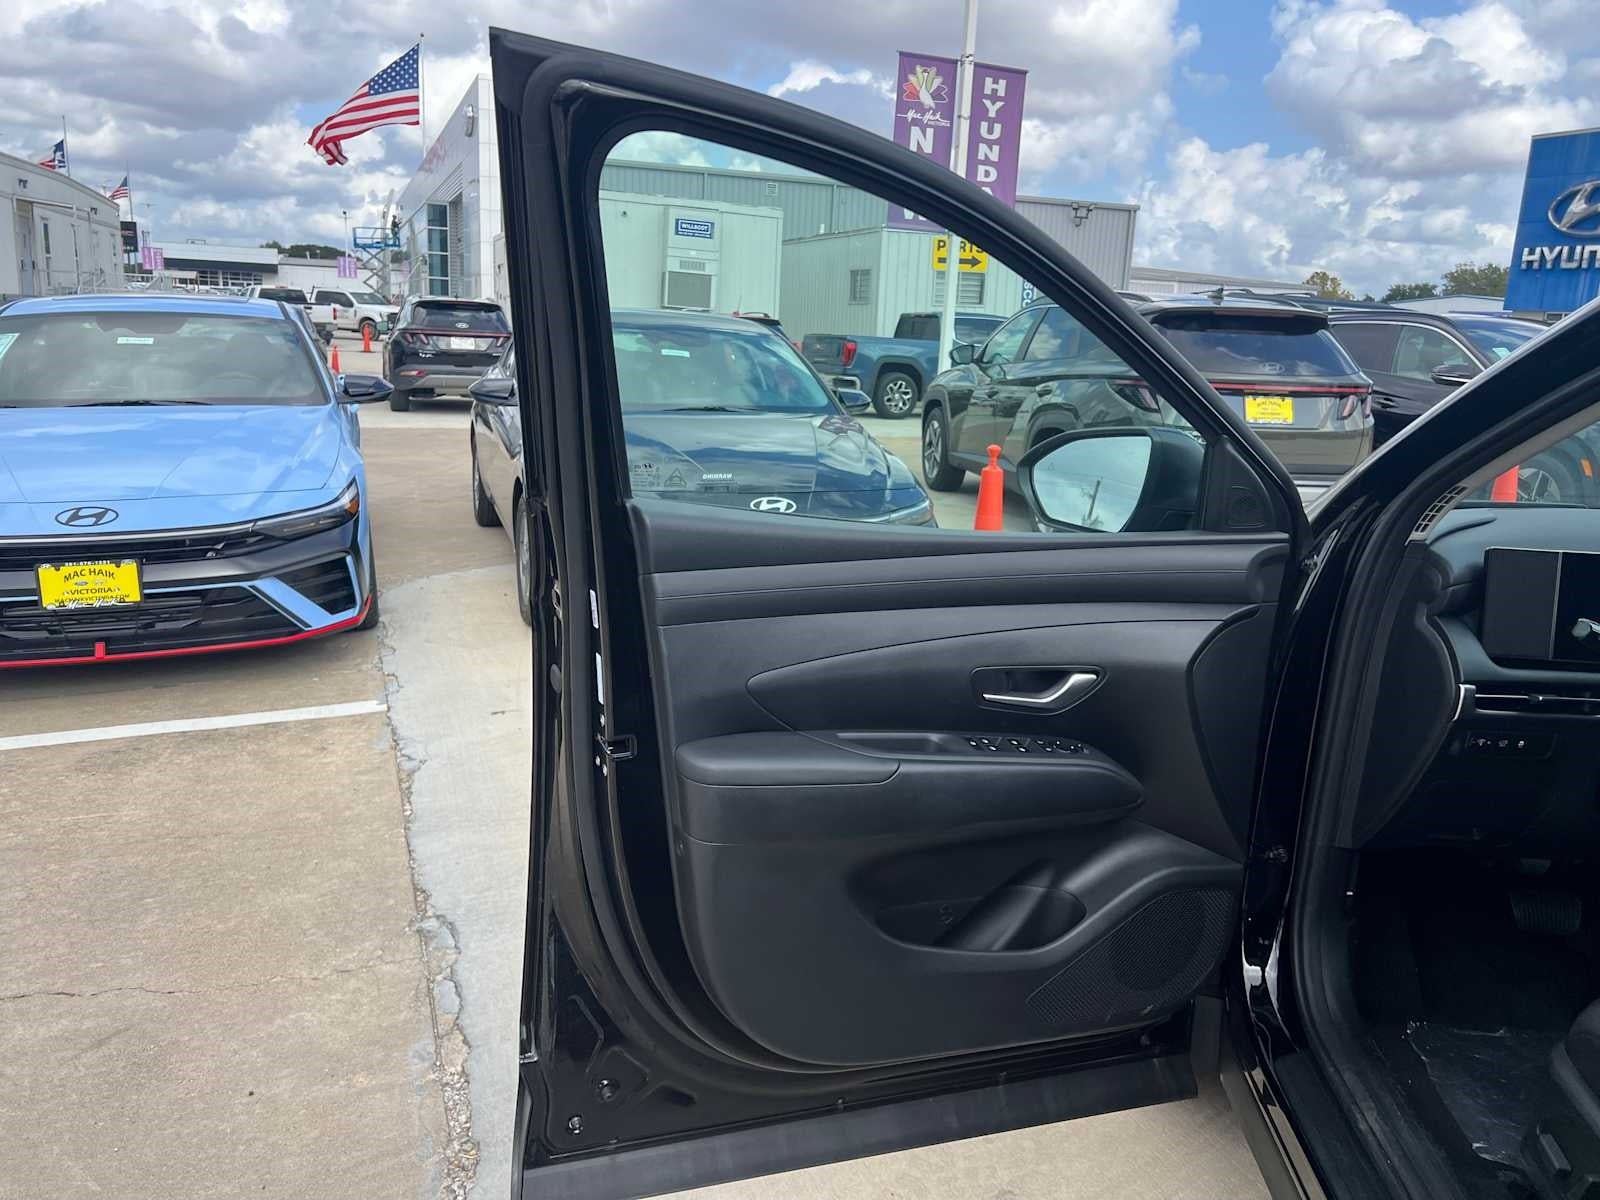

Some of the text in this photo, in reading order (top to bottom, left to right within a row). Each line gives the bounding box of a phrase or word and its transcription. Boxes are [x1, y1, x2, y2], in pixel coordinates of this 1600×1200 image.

[64, 568, 116, 583] MAC HAIK
[70, 587, 113, 595] VICTORIA
